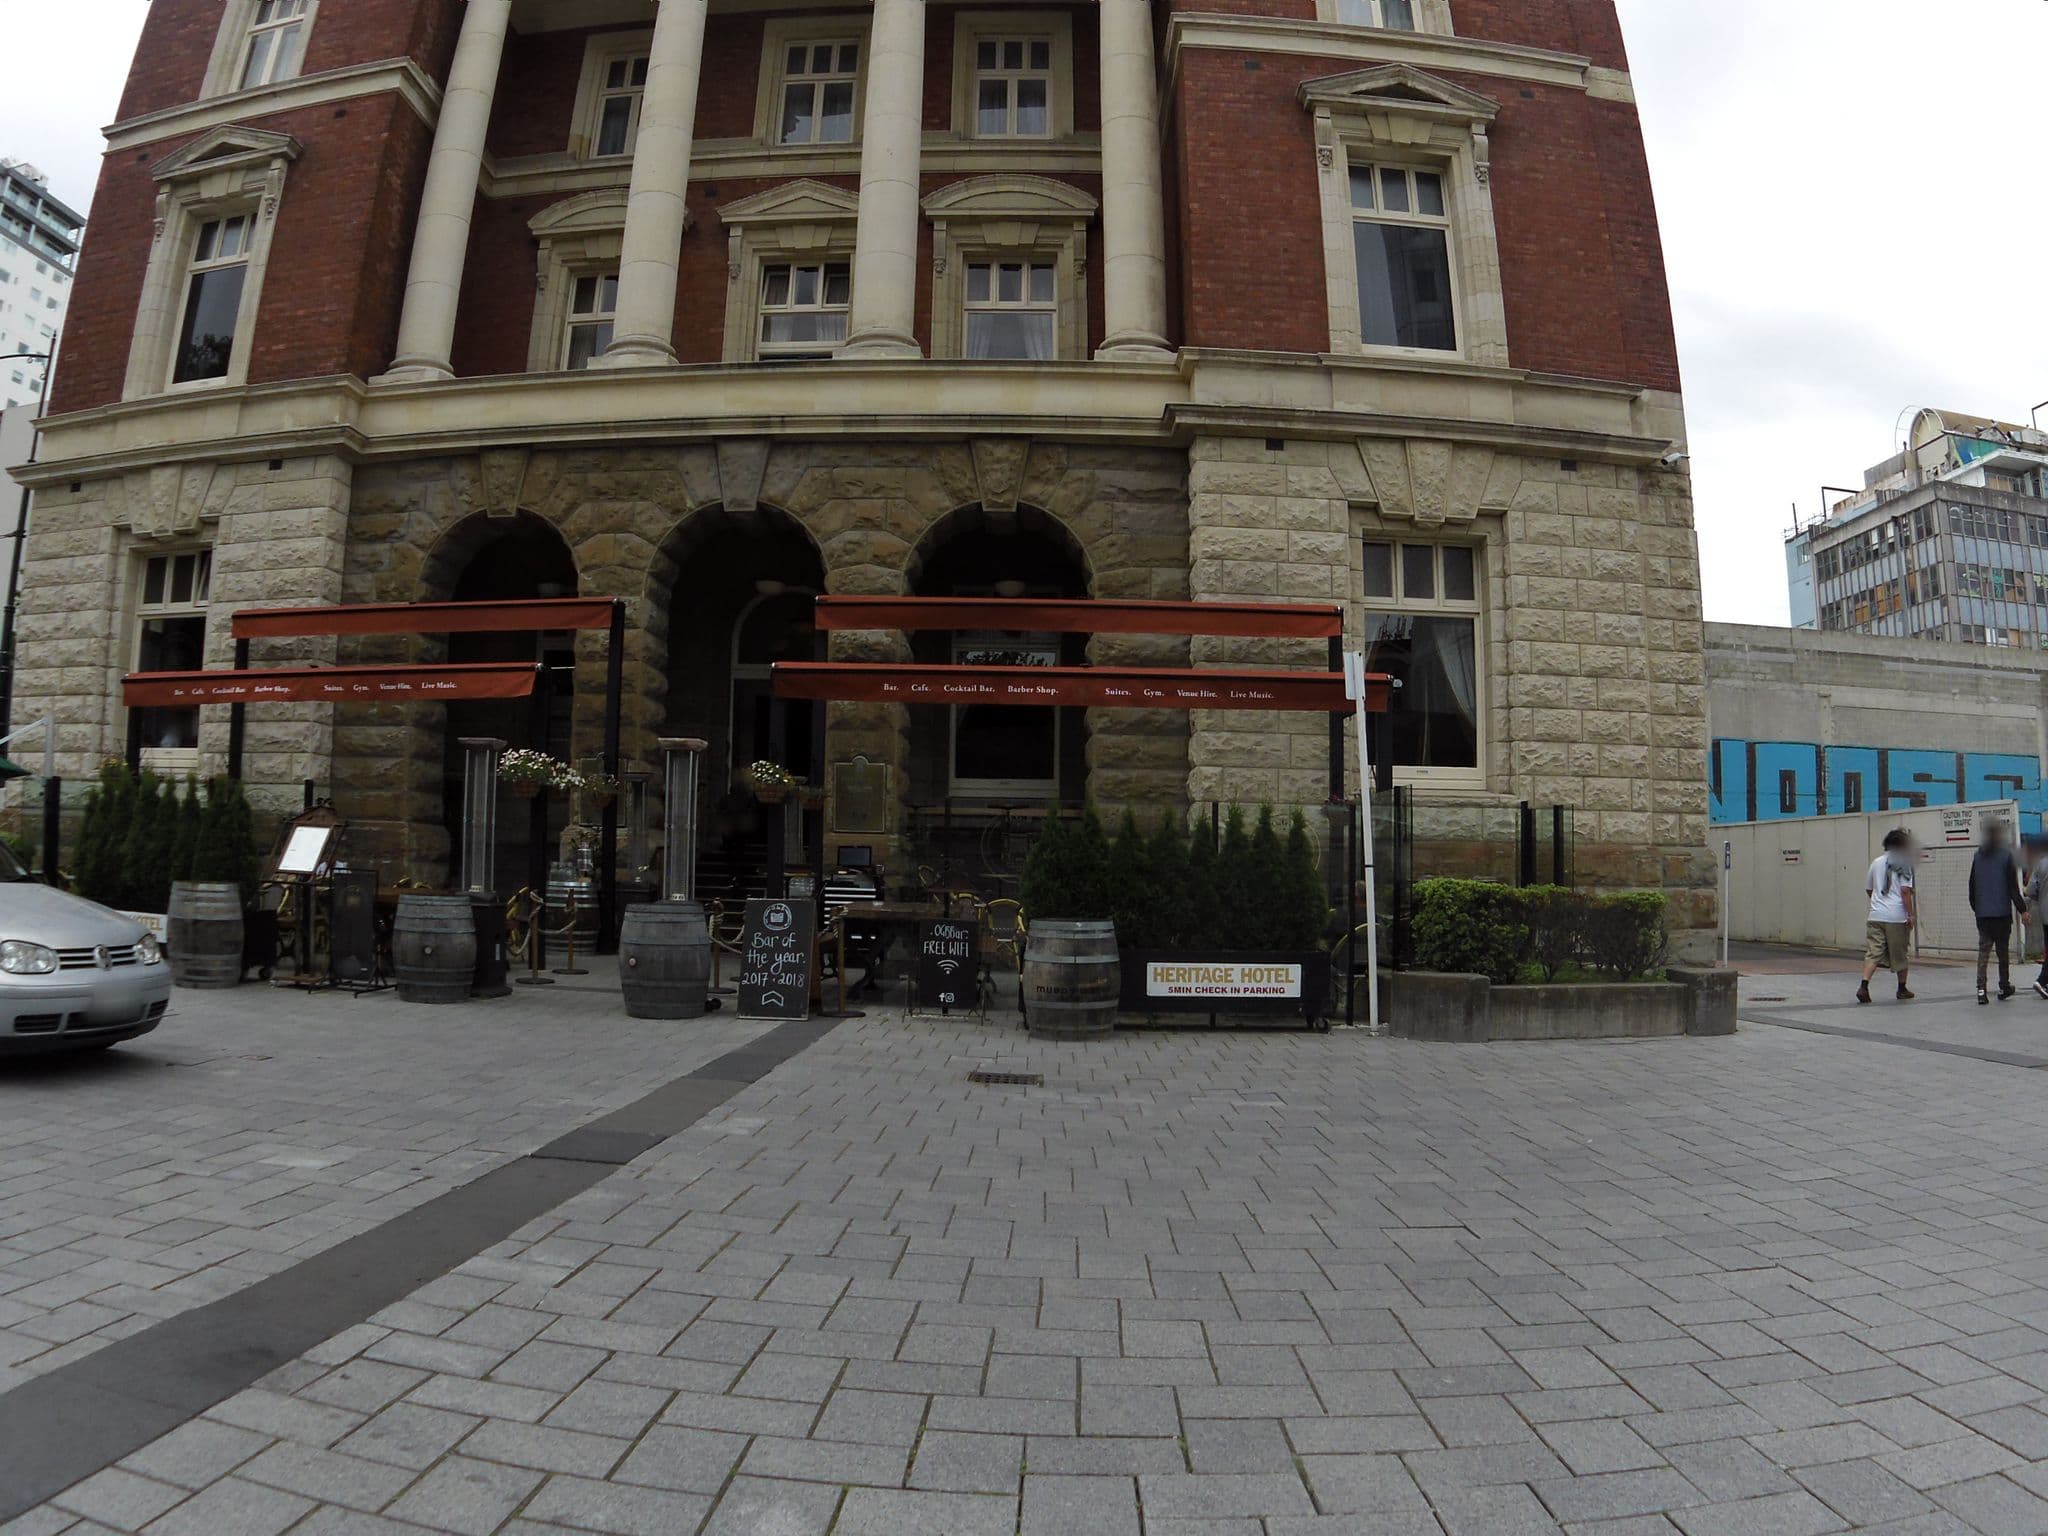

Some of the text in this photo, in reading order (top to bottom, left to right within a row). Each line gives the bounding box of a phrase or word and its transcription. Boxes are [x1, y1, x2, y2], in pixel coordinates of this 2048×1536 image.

[943, 684, 977, 692] Cocktail
[1007, 685, 1034, 694] Barber
[1036, 685, 1060, 696] Shop.
[1104, 687, 1132, 696] Suites.
[1143, 688, 1165, 698] Gym.
[1177, 689, 1198, 697] Venue
[1230, 690, 1247, 698] Live
[752, 932, 797, 949] Bar of
[923, 940, 969, 958] FREE WIFI
[746, 949, 768, 968] the
[741, 972, 805, 988] 2017 2018
[1153, 966, 1295, 984] HERITAGE HOTEL
[1168, 986, 1286, 995] 5MIN CHECK IN PARKING
